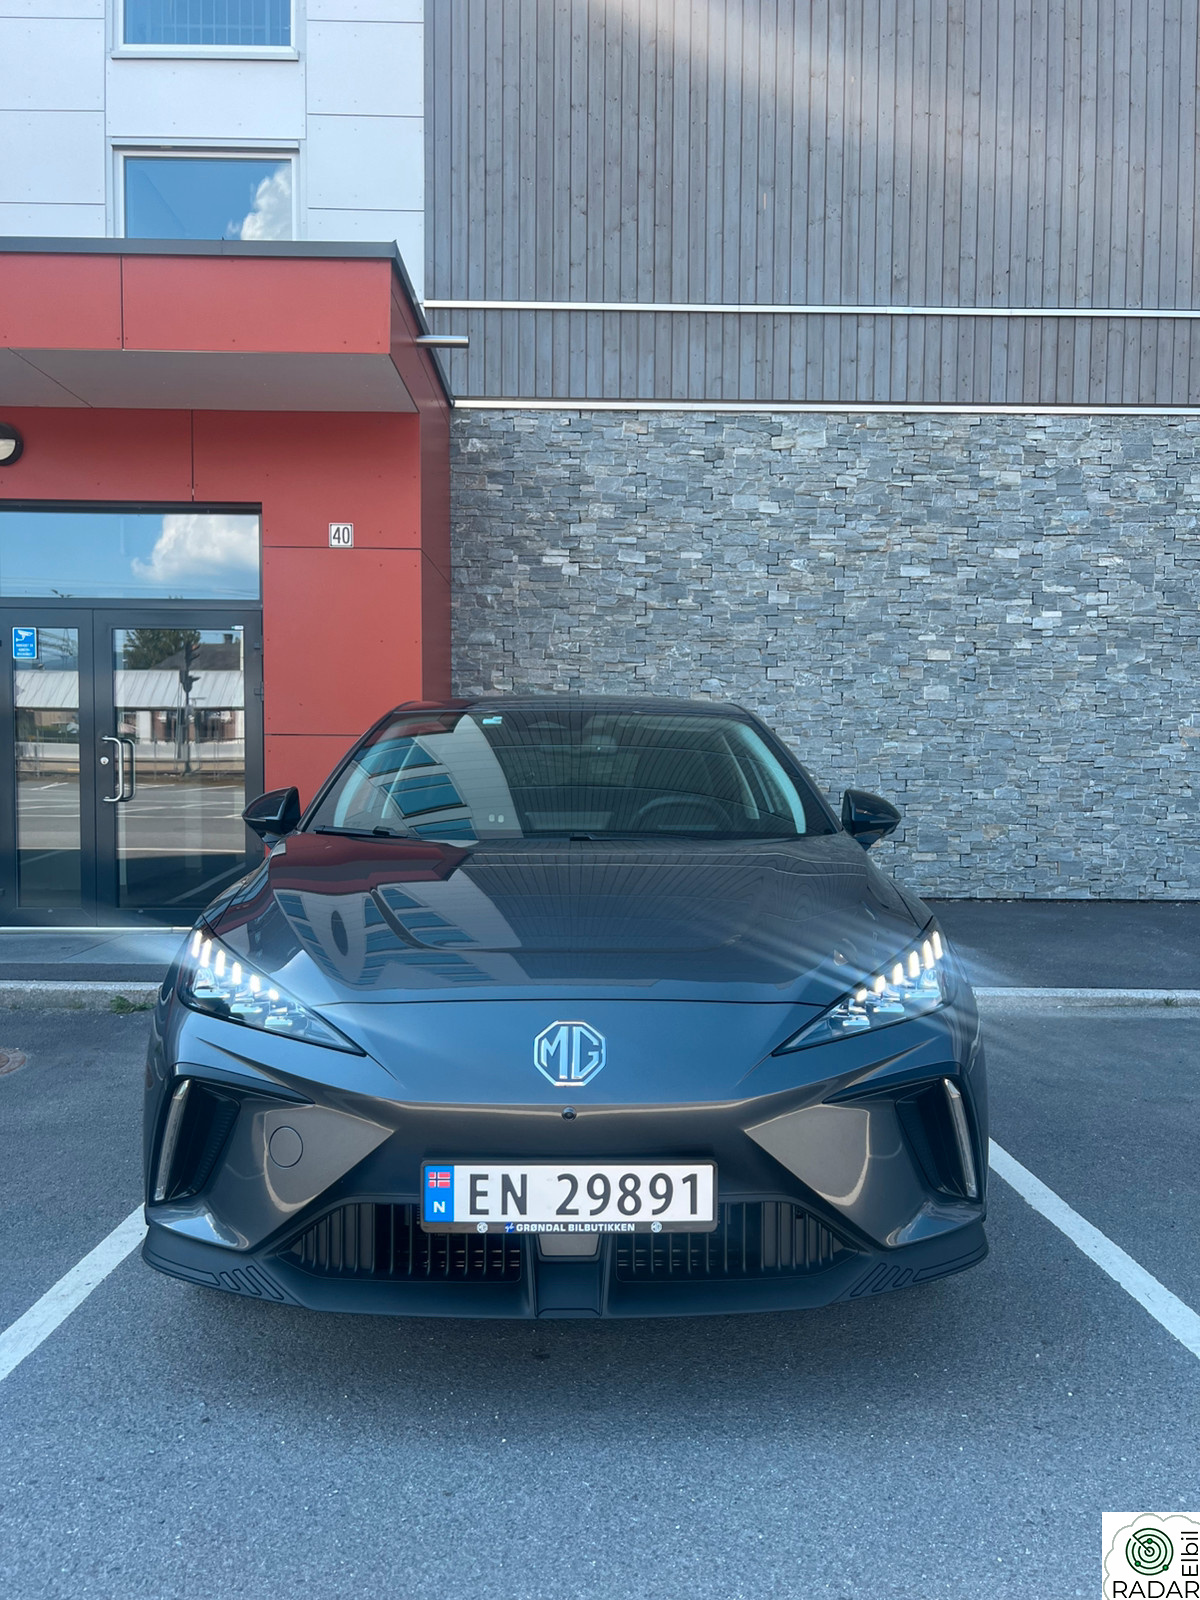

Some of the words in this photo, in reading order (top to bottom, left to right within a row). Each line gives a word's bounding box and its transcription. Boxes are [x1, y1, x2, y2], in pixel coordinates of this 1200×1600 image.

[333, 526, 350, 544] 40
[541, 1026, 600, 1080] MG
[469, 1173, 528, 1216] EN
[555, 1172, 698, 1217] 29891
[433, 1200, 446, 1213] N
[516, 1223, 566, 1232] GRØNDAL
[568, 1223, 635, 1232] BILBUTIKKEN
